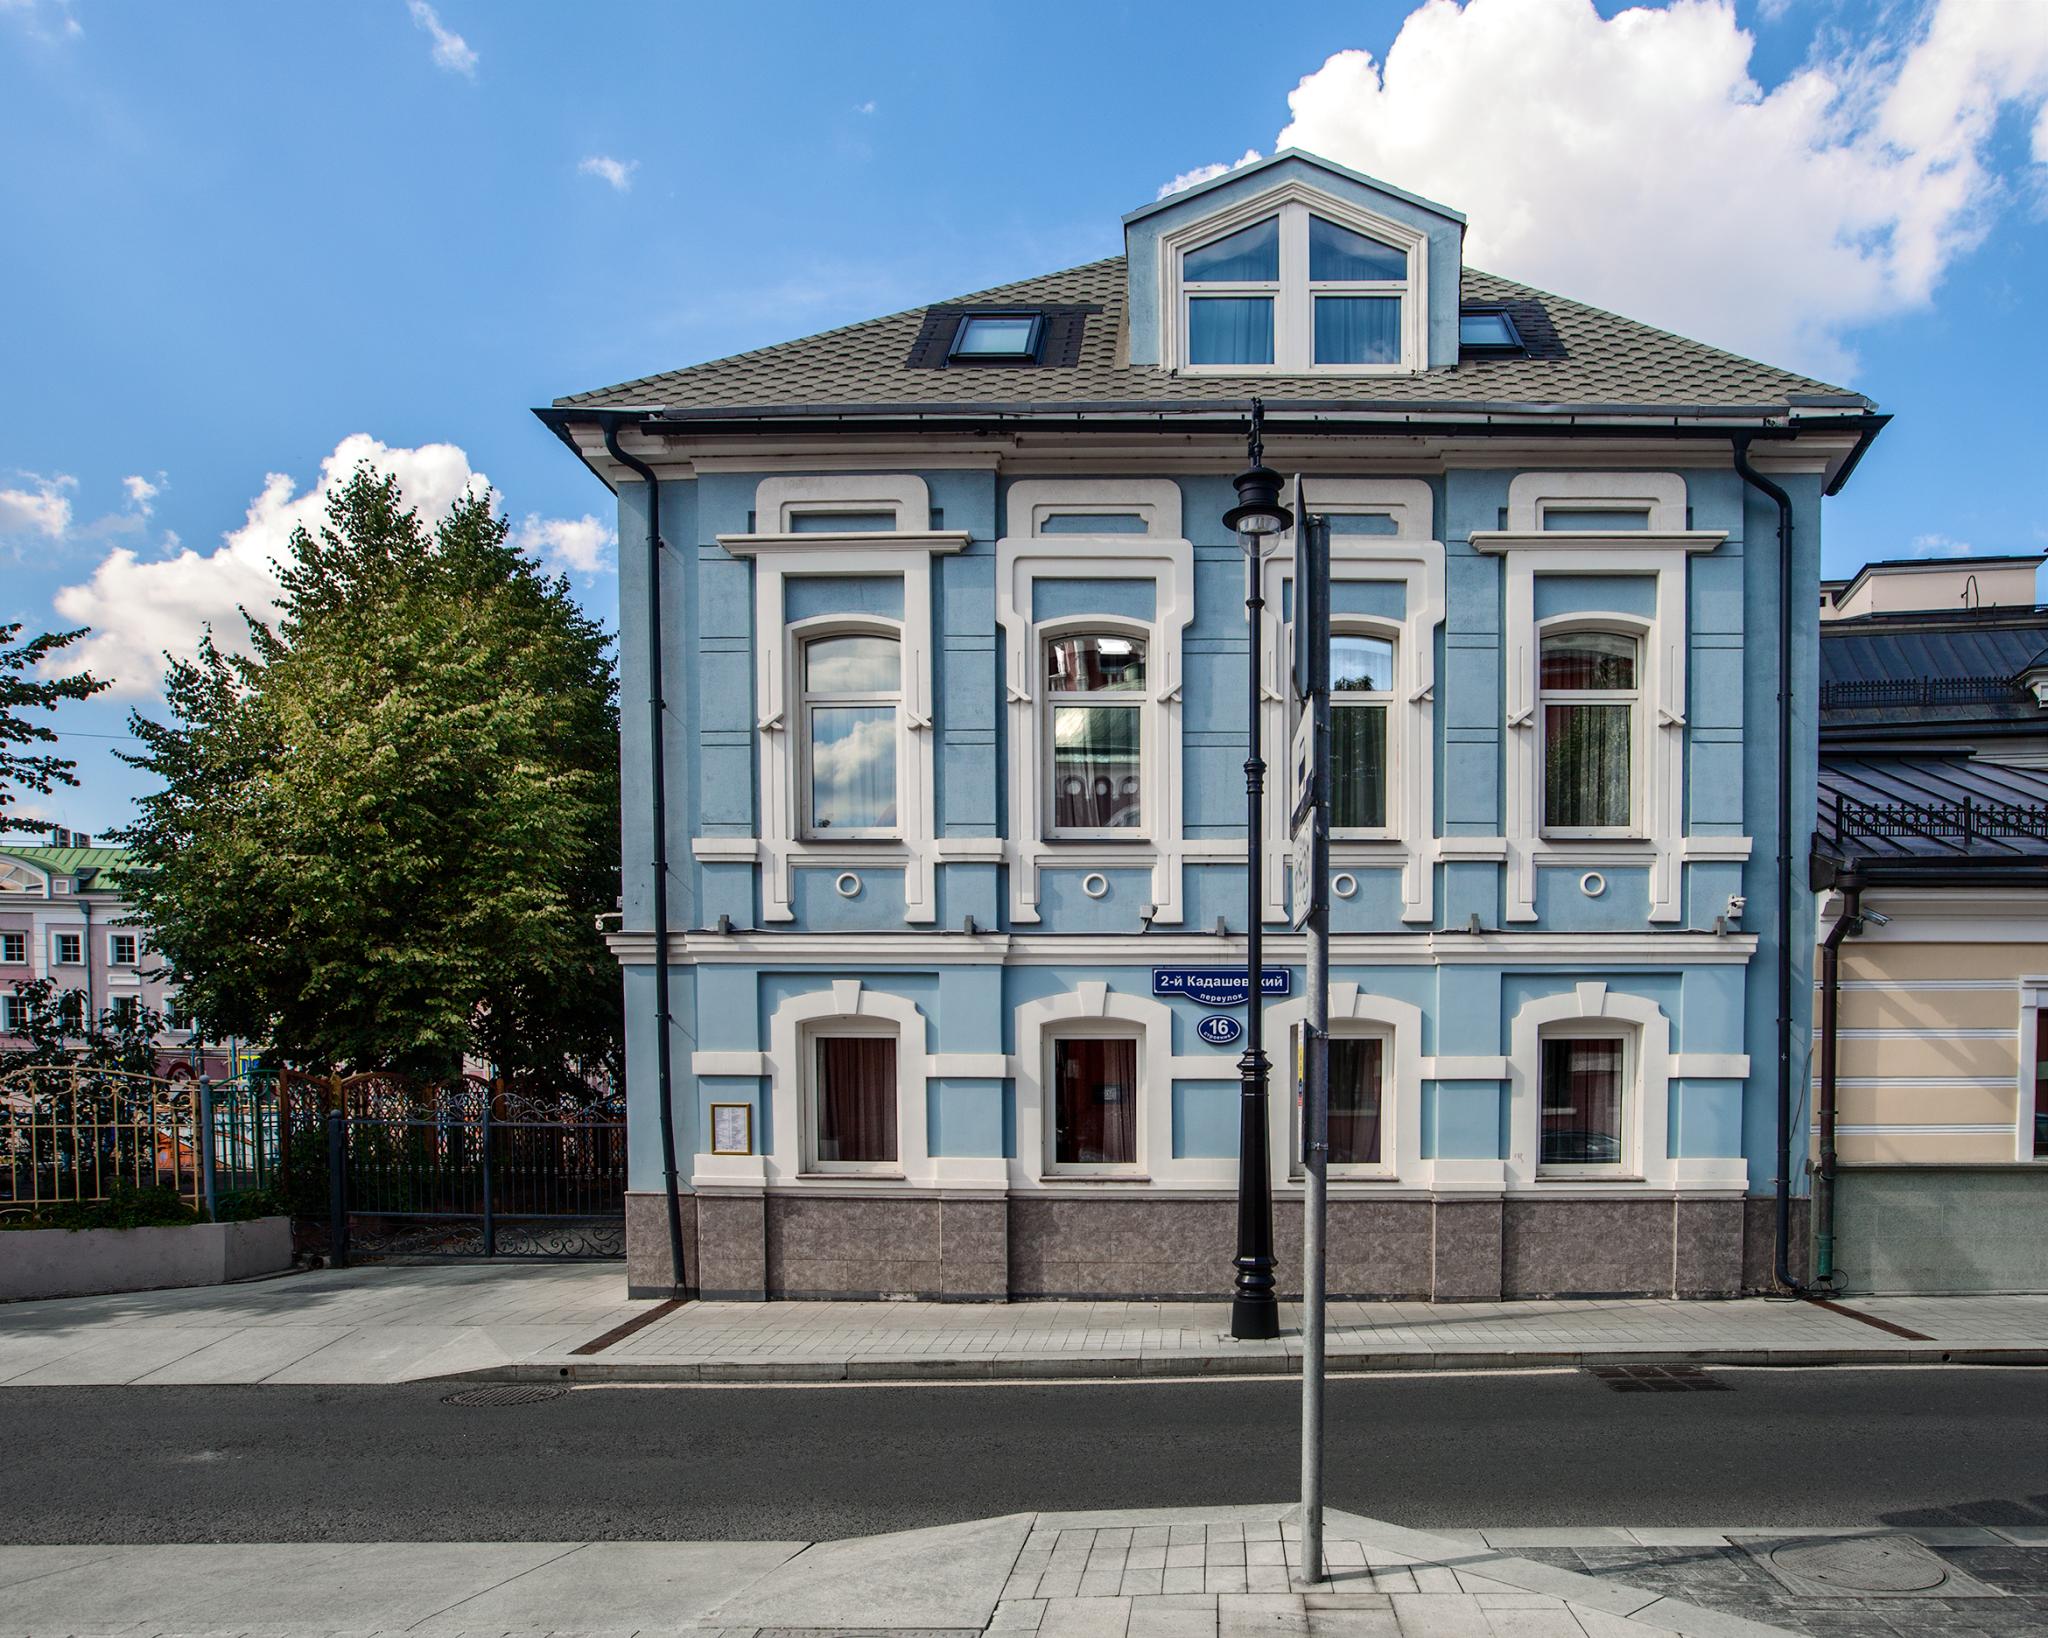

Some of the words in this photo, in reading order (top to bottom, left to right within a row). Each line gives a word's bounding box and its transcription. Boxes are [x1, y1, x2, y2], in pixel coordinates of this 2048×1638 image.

[1160, 976, 1182, 986] 2-й
[1187, 976, 1283, 988] Кадашевкий
[1200, 993, 1243, 1003] переулок
[1209, 1019, 1229, 1035] 16
